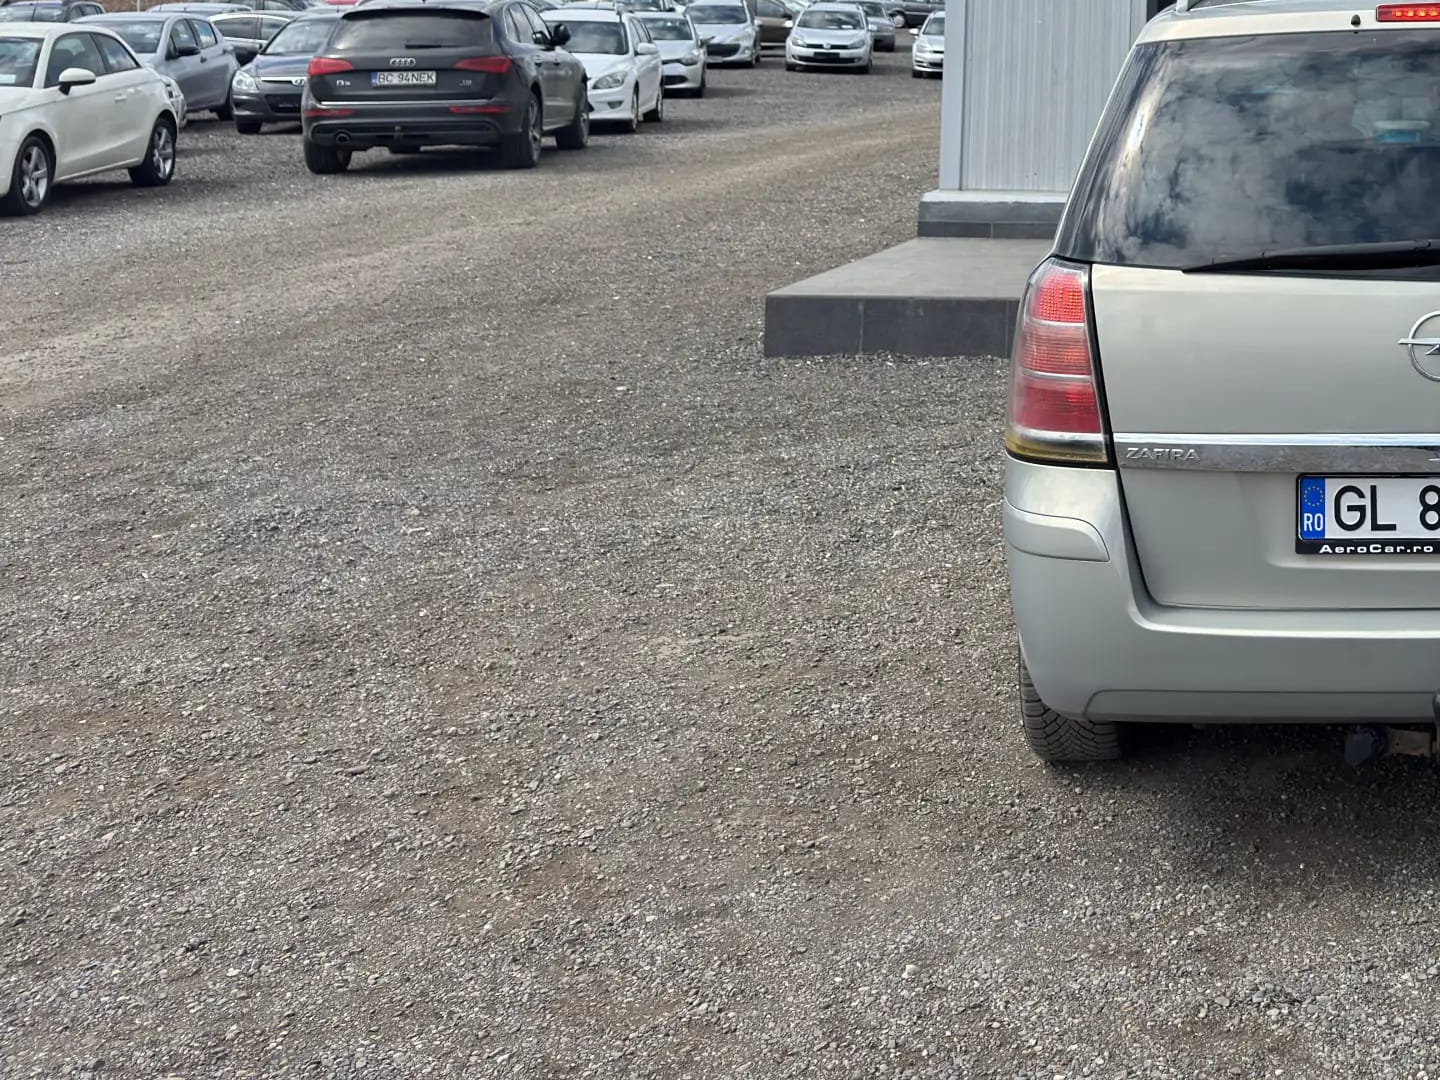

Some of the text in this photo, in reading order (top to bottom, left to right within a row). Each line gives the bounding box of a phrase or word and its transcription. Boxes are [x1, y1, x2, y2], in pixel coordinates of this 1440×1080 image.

[1126, 447, 1200, 461] ZAFIRA
[1334, 484, 1397, 532] GL
[1303, 512, 1324, 532] RO
[1319, 544, 1434, 554] AeroCar.ro
